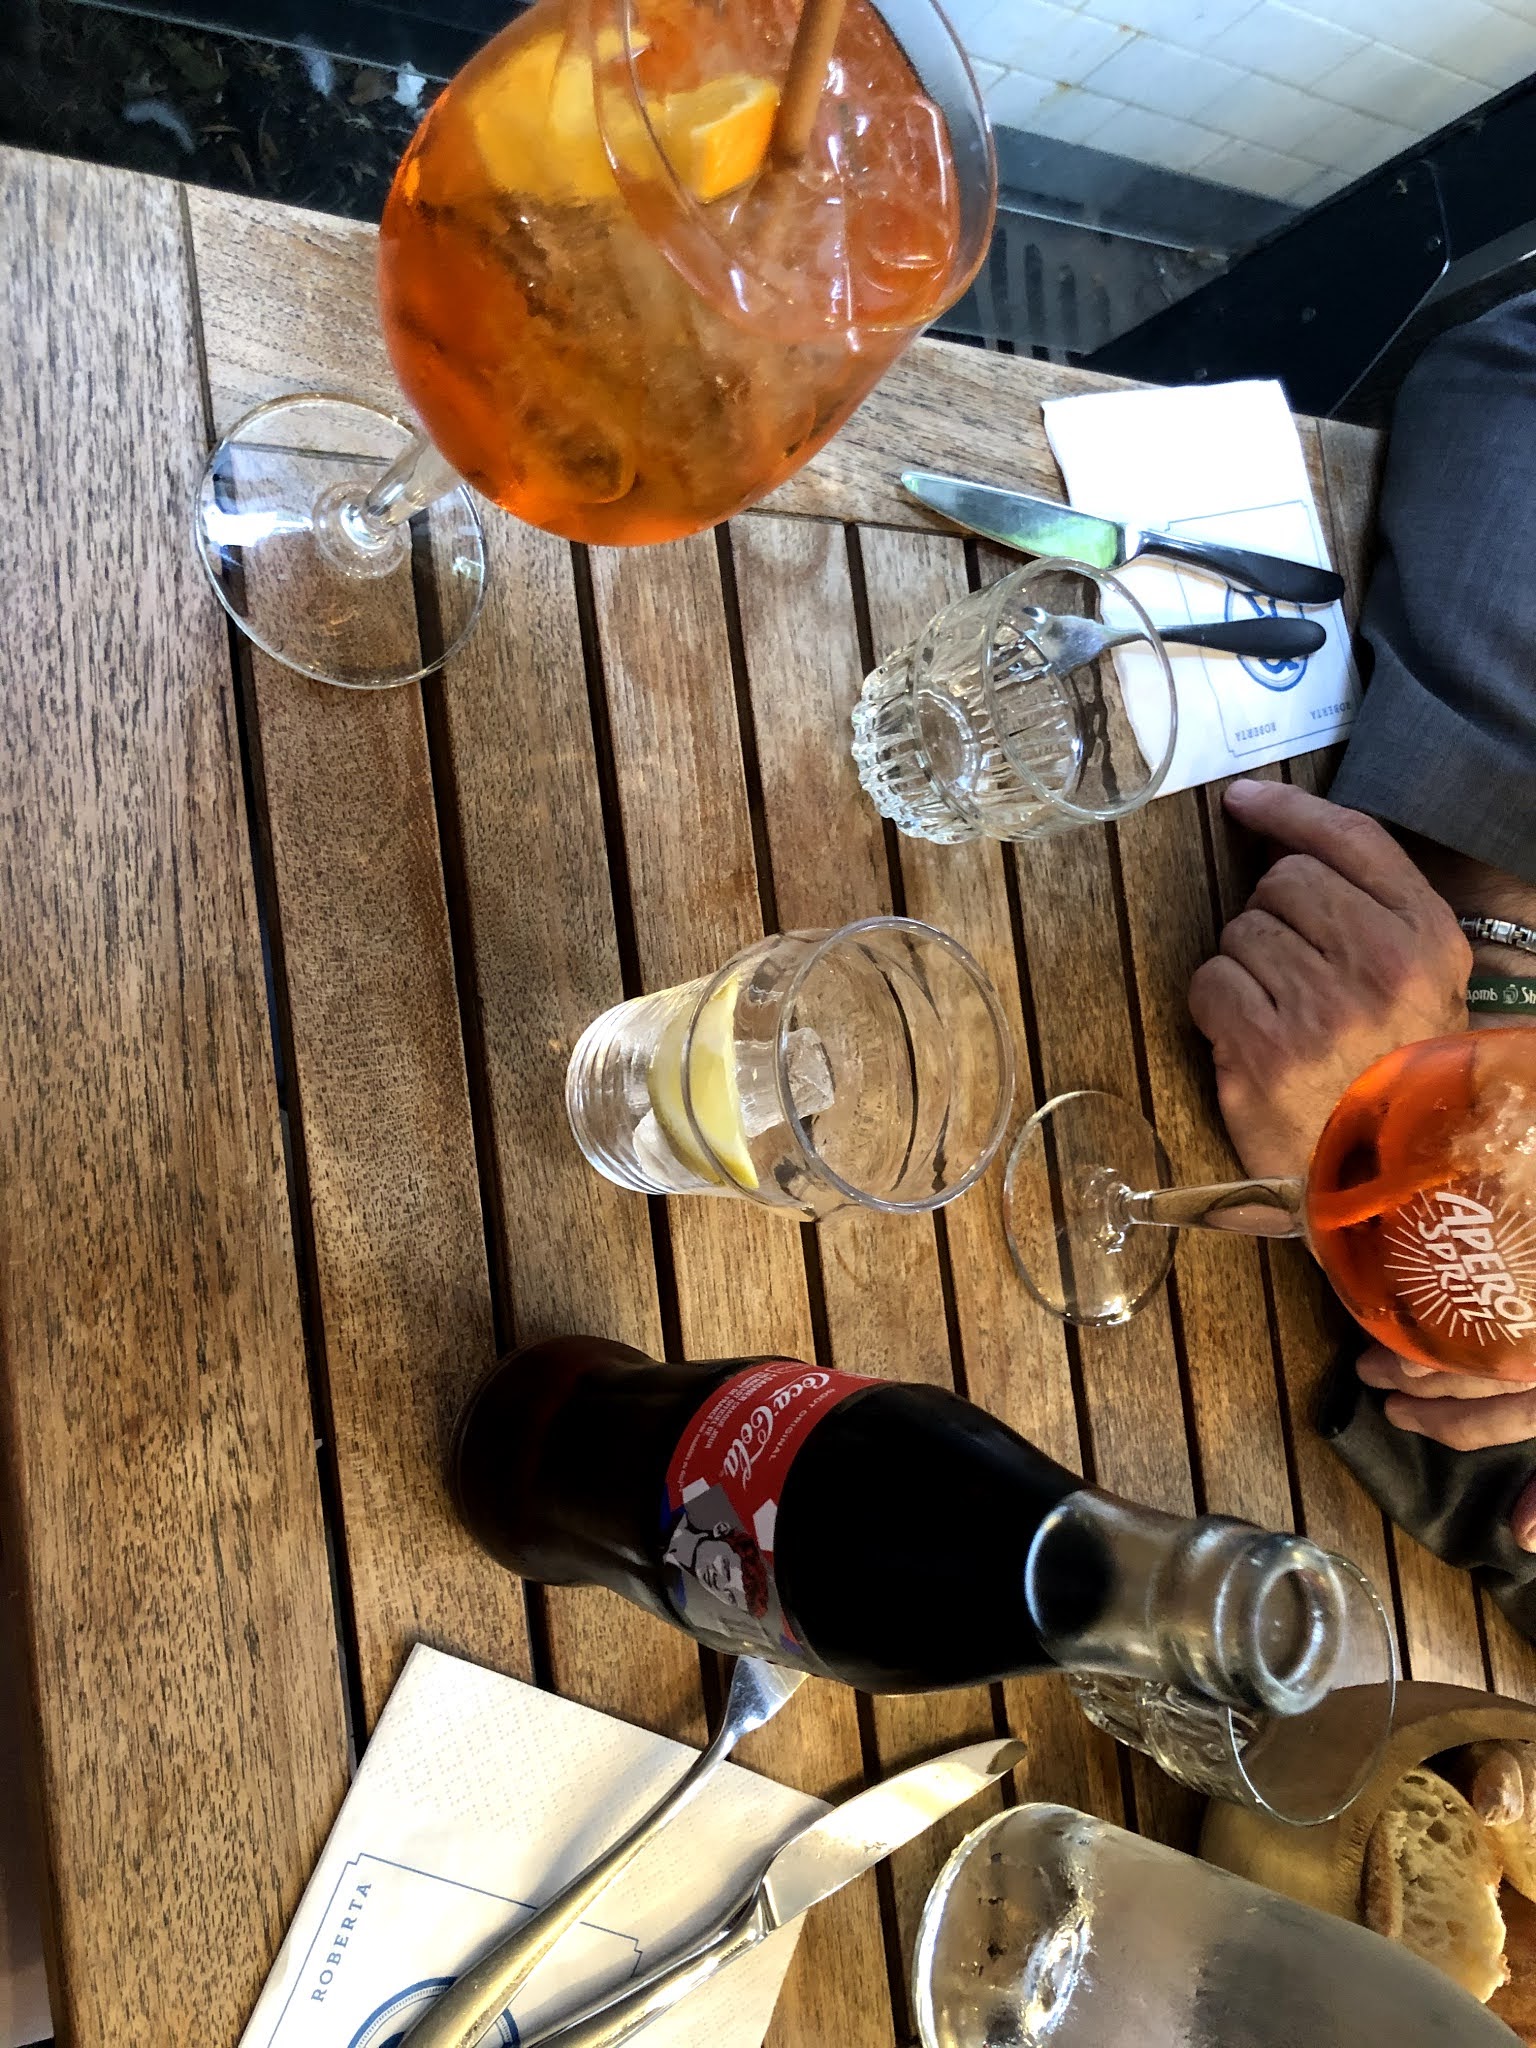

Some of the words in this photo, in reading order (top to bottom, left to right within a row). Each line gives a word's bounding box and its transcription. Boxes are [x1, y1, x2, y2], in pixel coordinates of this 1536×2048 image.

[1234, 722, 1277, 741] ROBERTA
[1435, 1191, 1536, 1339] APEROL
[769, 1410, 808, 1462] ORIGINAL
[311, 1882, 372, 2003] ROBERTA
